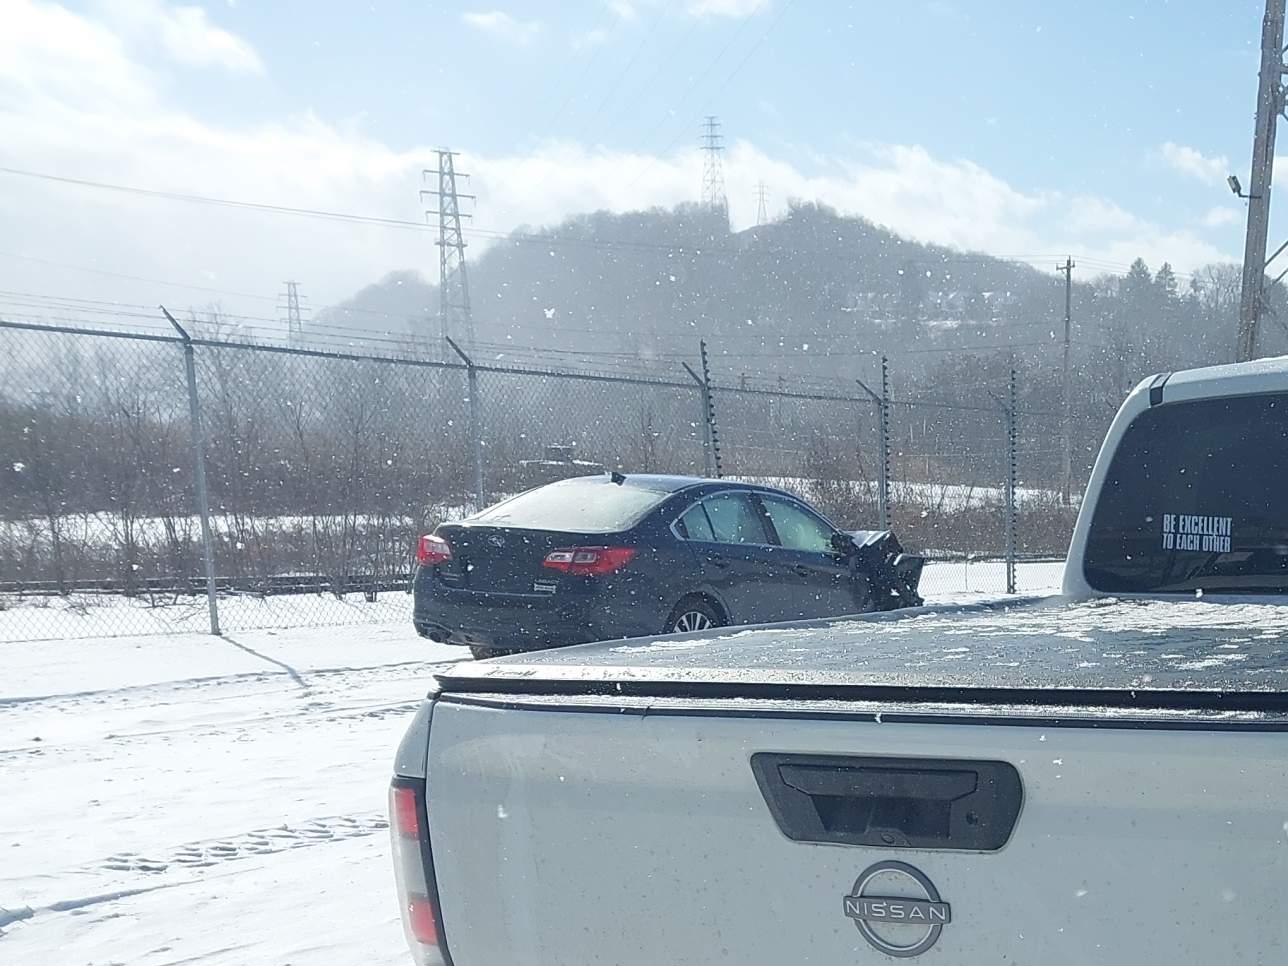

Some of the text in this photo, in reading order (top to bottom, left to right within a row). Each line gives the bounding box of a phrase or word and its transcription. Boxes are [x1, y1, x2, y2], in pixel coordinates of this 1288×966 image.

[1163, 514, 1232, 535] BE EXCELLENT
[1162, 533, 1231, 552] TO EACH OTHER
[845, 900, 946, 921] NISSAN
